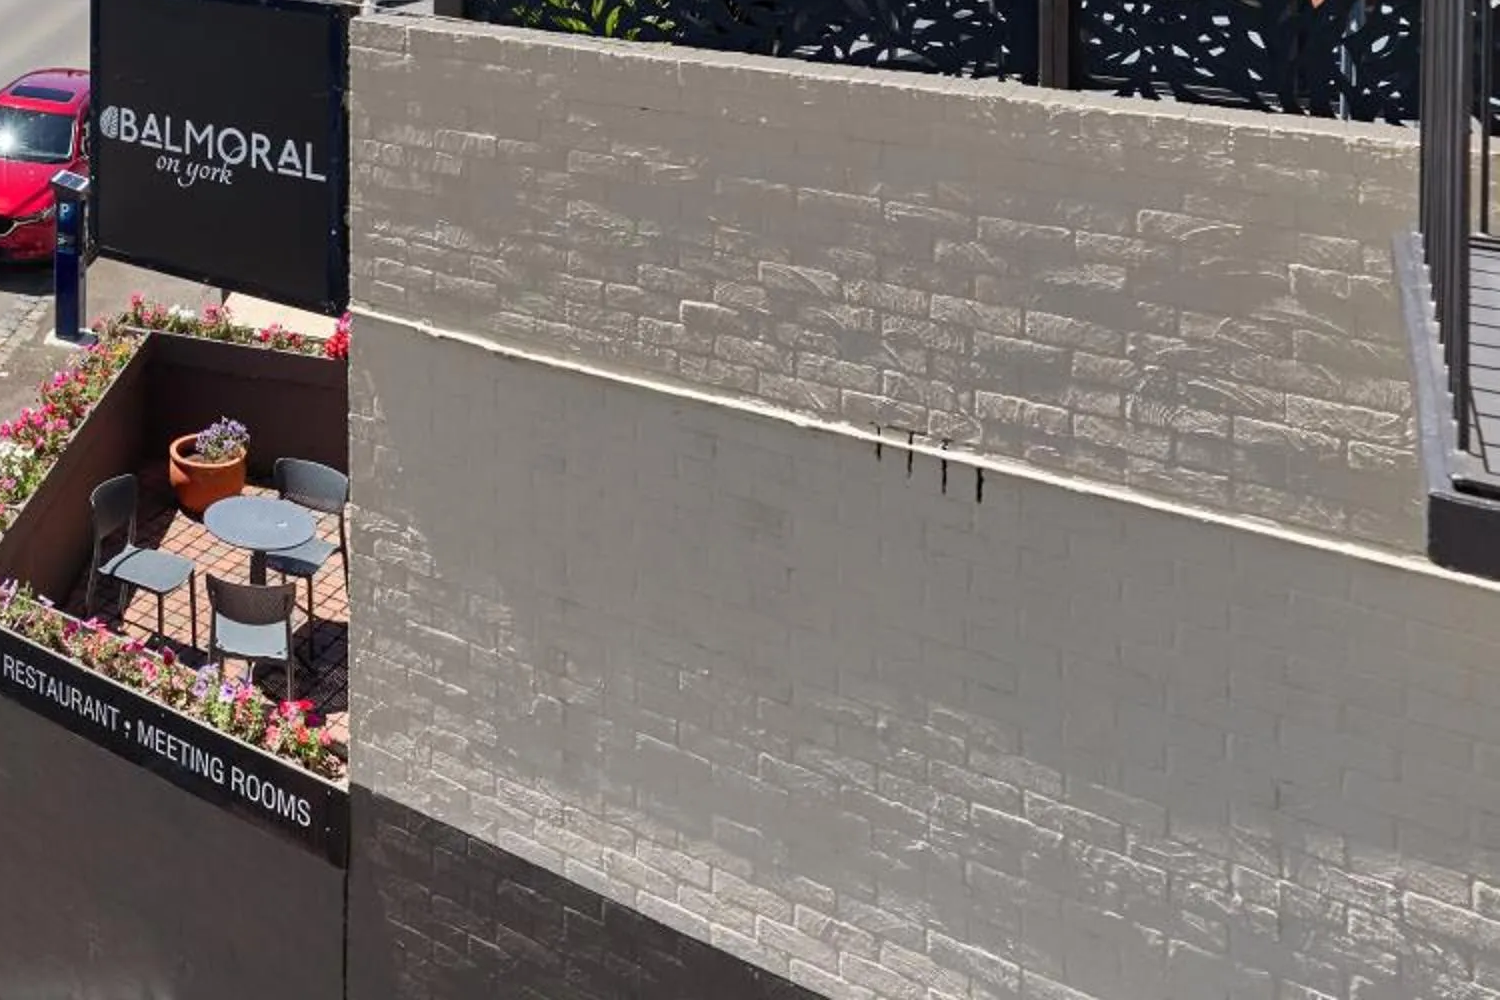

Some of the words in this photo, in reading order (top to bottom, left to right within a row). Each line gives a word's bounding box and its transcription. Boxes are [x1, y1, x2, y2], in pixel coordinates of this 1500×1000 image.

[119, 107, 327, 183] BALMORAL
[155, 155, 181, 174] on
[177, 160, 233, 188] york
[59, 202, 70, 220] P
[2, 652, 120, 732] RESTAURANT
[136, 718, 225, 786] MEETING
[230, 765, 312, 828] ROOMS
